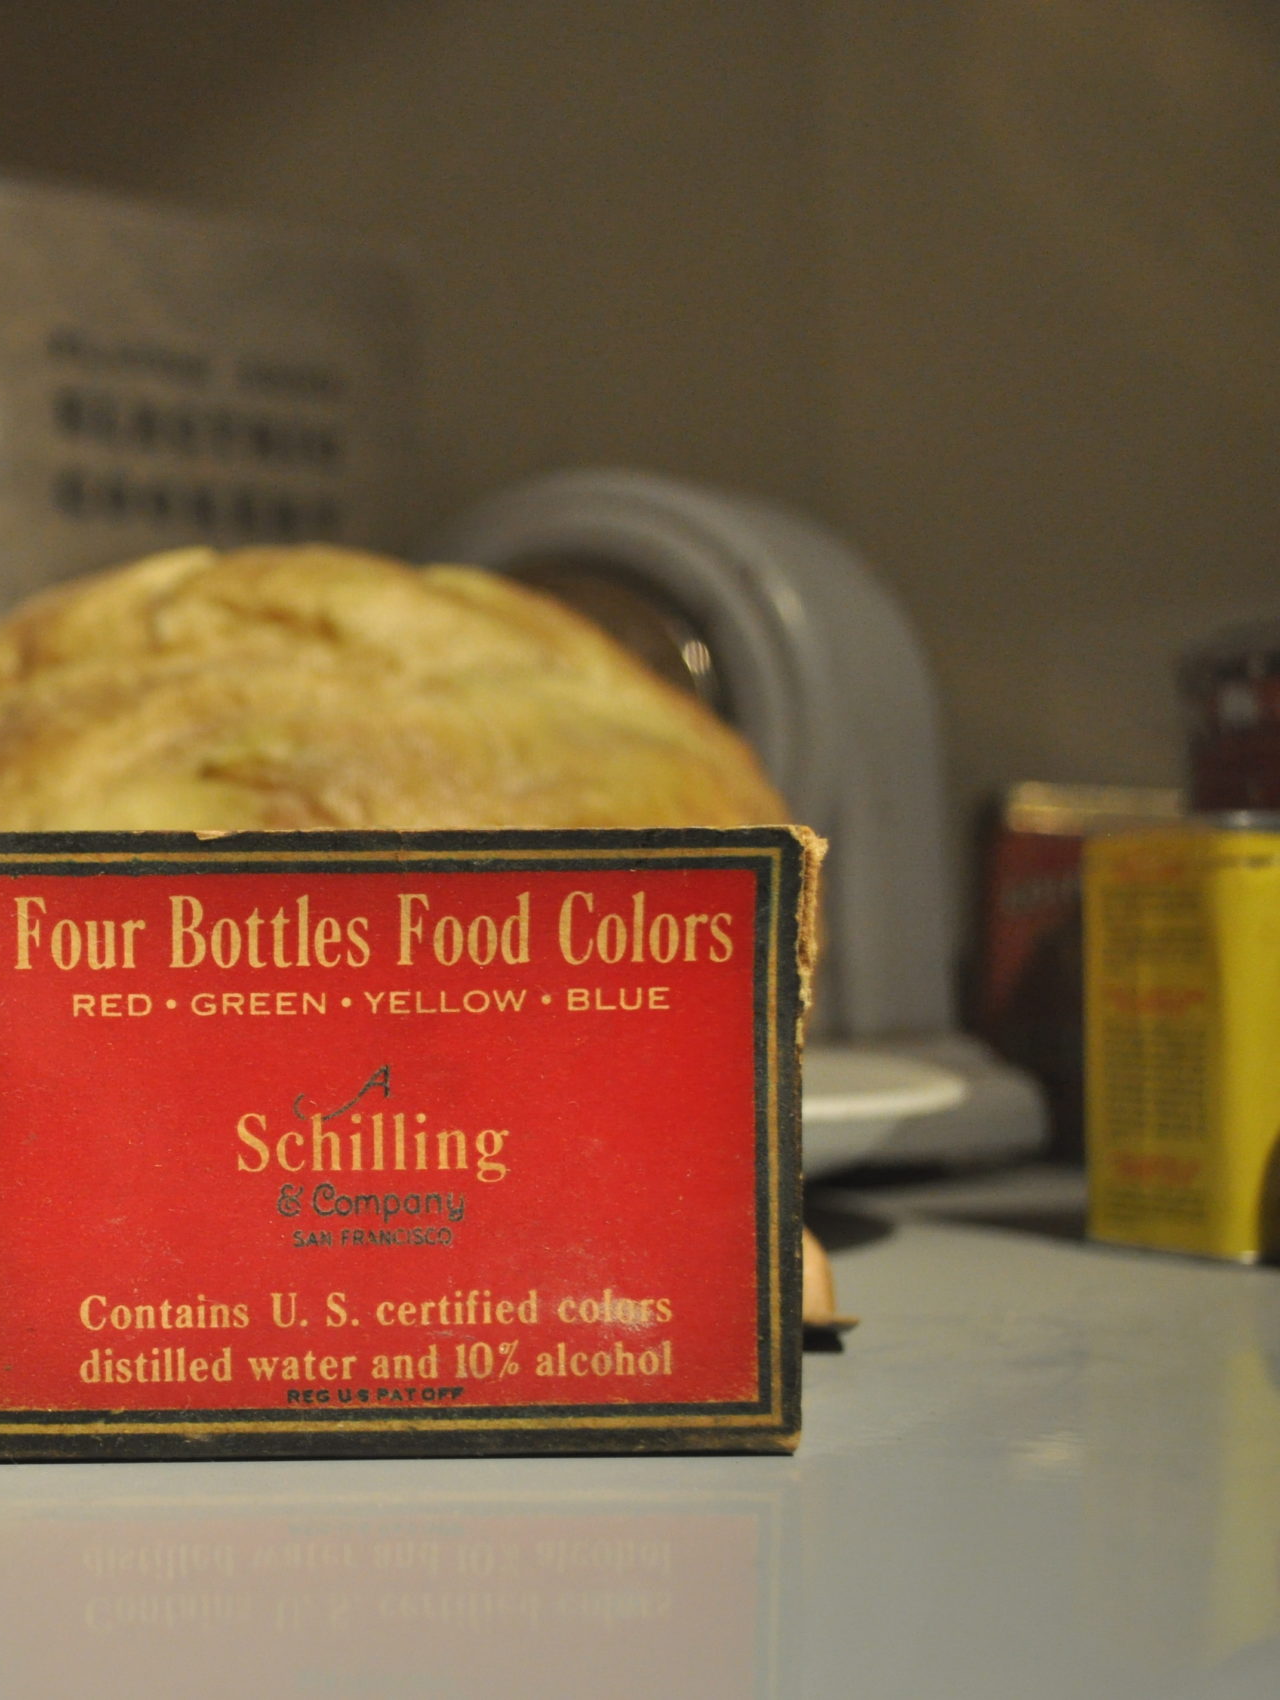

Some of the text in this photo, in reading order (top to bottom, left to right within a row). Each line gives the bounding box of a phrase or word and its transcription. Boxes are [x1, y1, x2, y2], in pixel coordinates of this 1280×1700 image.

[13, 891, 733, 971] Four Bottles Food Colors
[72, 986, 670, 1017] RED GREEN YELLOW BLUE
[236, 1112, 510, 1183] Schilling
[276, 1182, 465, 1223] & Company
[292, 1226, 454, 1249] SAN FRANCISCO
[79, 1287, 673, 1332] Contains U. S. certified colors
[79, 1339, 673, 1384] distilled water and 10% alcohol
[286, 1389, 331, 1403] REG
[376, 1387, 417, 1402] PAT
[421, 1386, 465, 1402] OFF
